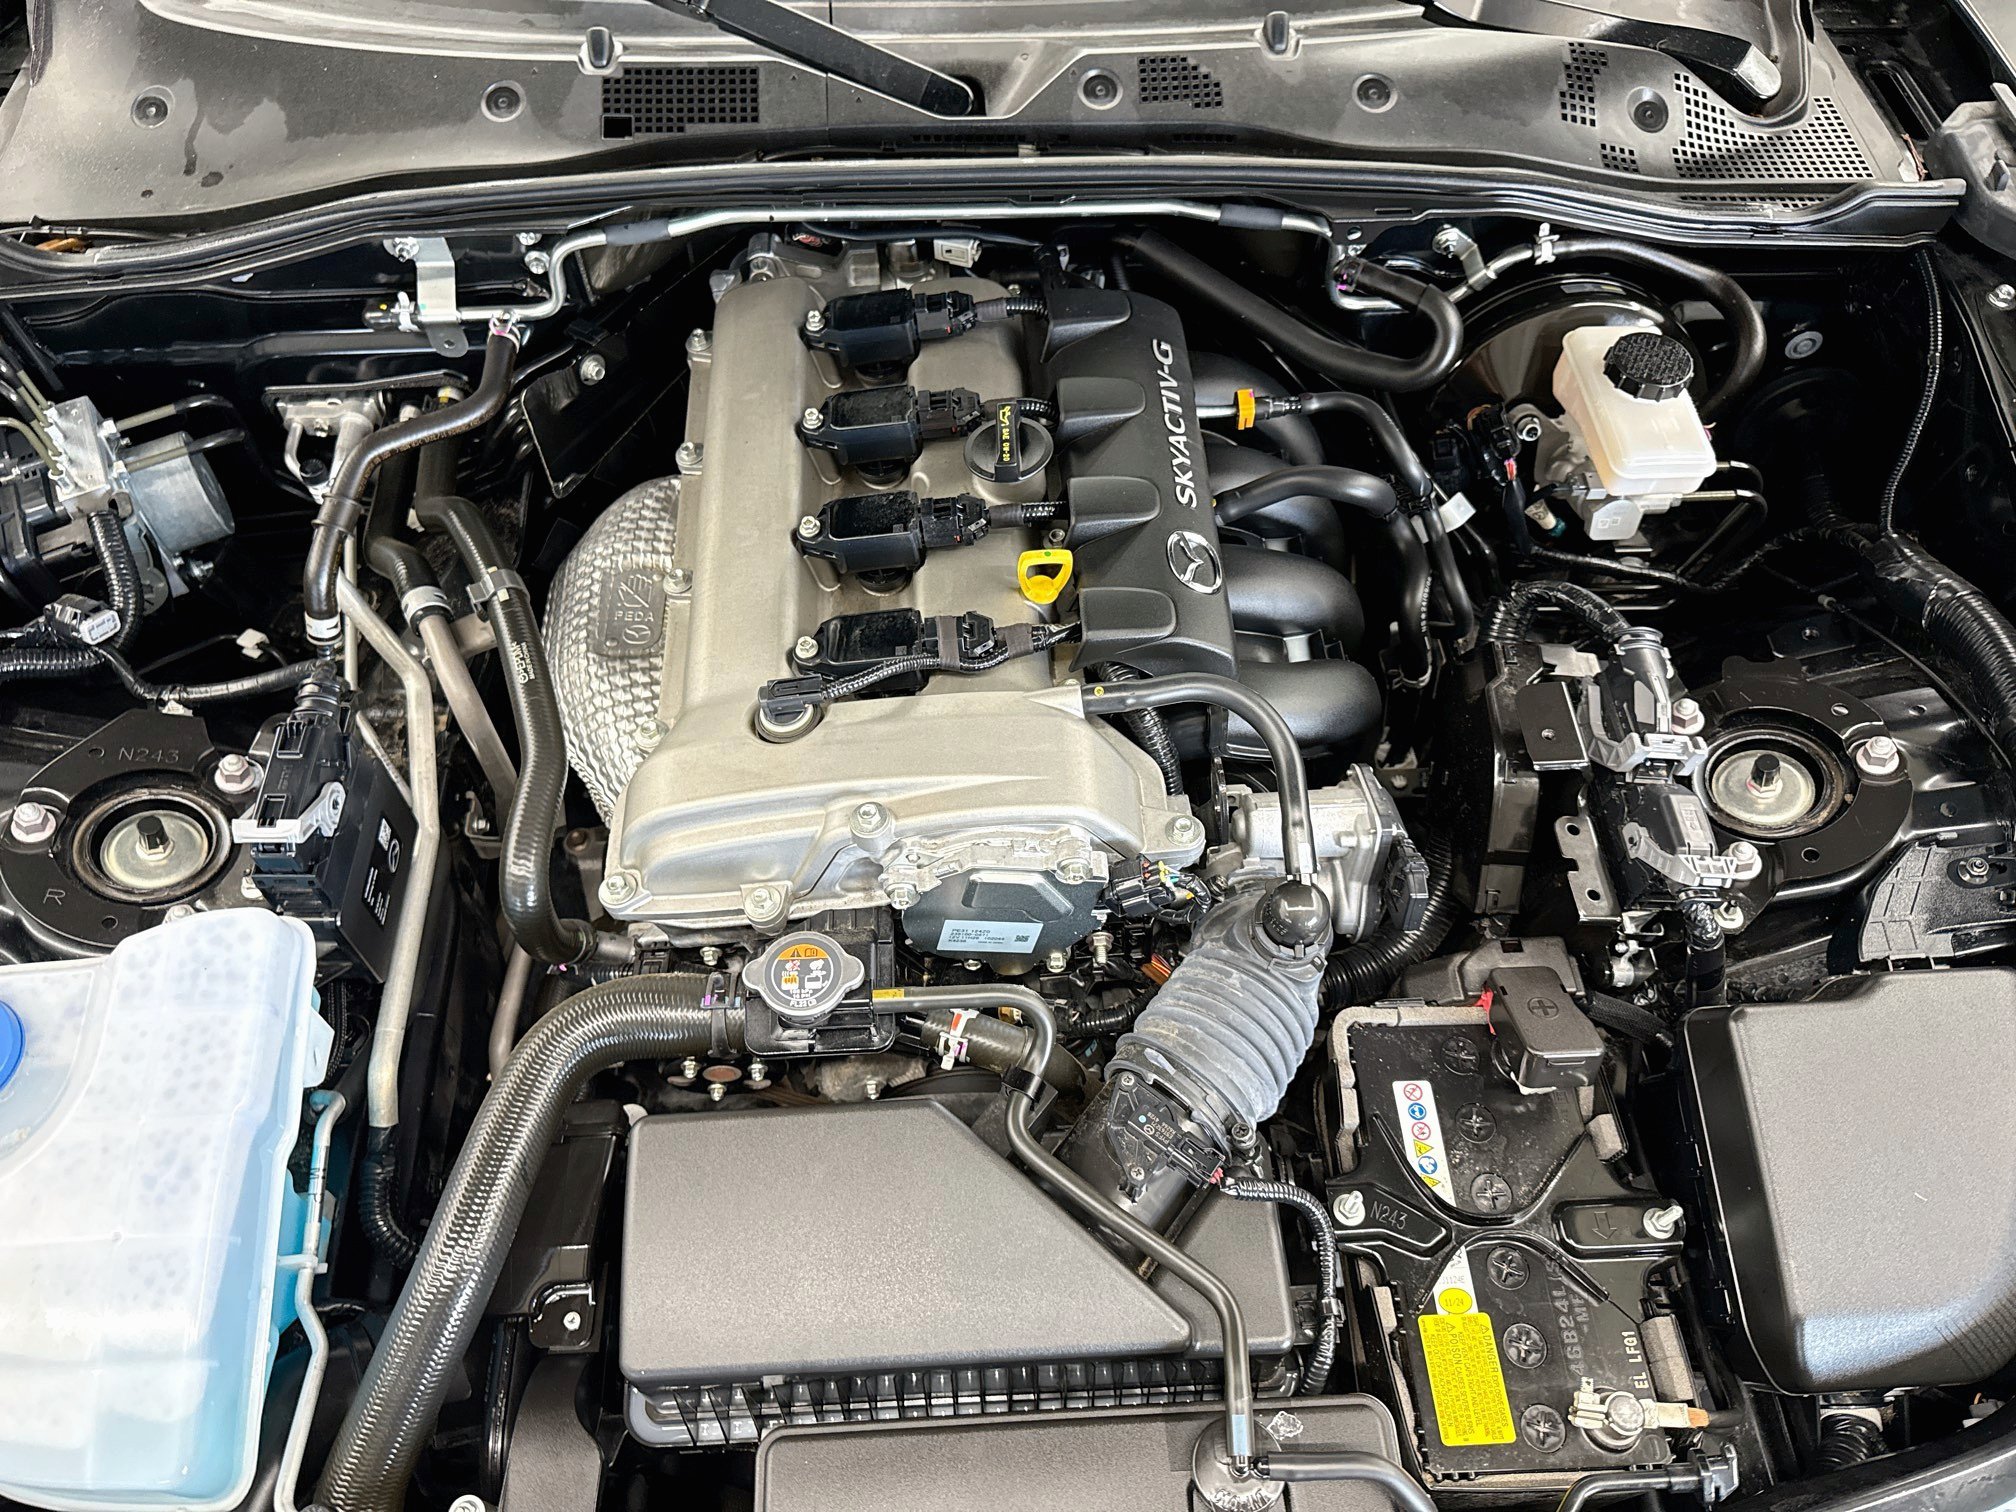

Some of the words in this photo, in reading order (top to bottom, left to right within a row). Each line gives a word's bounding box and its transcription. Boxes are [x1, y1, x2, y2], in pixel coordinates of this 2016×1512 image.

[1152, 339, 1197, 509] SKYACTIV-G
[1002, 428, 1010, 440] SAE
[614, 610, 654, 622] PEDA
[118, 747, 179, 764] N243
[43, 888, 66, 905] R
[1370, 1201, 1408, 1230] N243
[1444, 1298, 1464, 1307] 11/24
[1447, 1333, 1462, 1365] POISON
[1482, 1334, 1499, 1373] DANGER
[1621, 1331, 1642, 1363] LFG1
[1454, 1366, 1466, 1389] CAUSES
[1463, 1362, 1473, 1377] CAPS
[1466, 1378, 1476, 1395] TIGHT
[1632, 1371, 1650, 1389] EL
[1490, 1374, 1504, 1407] EXPLOSIVE
[1459, 1390, 1470, 1412] SEVERE
[1470, 1395, 1479, 1408] AND
[1497, 1406, 1509, 1427] GASES
